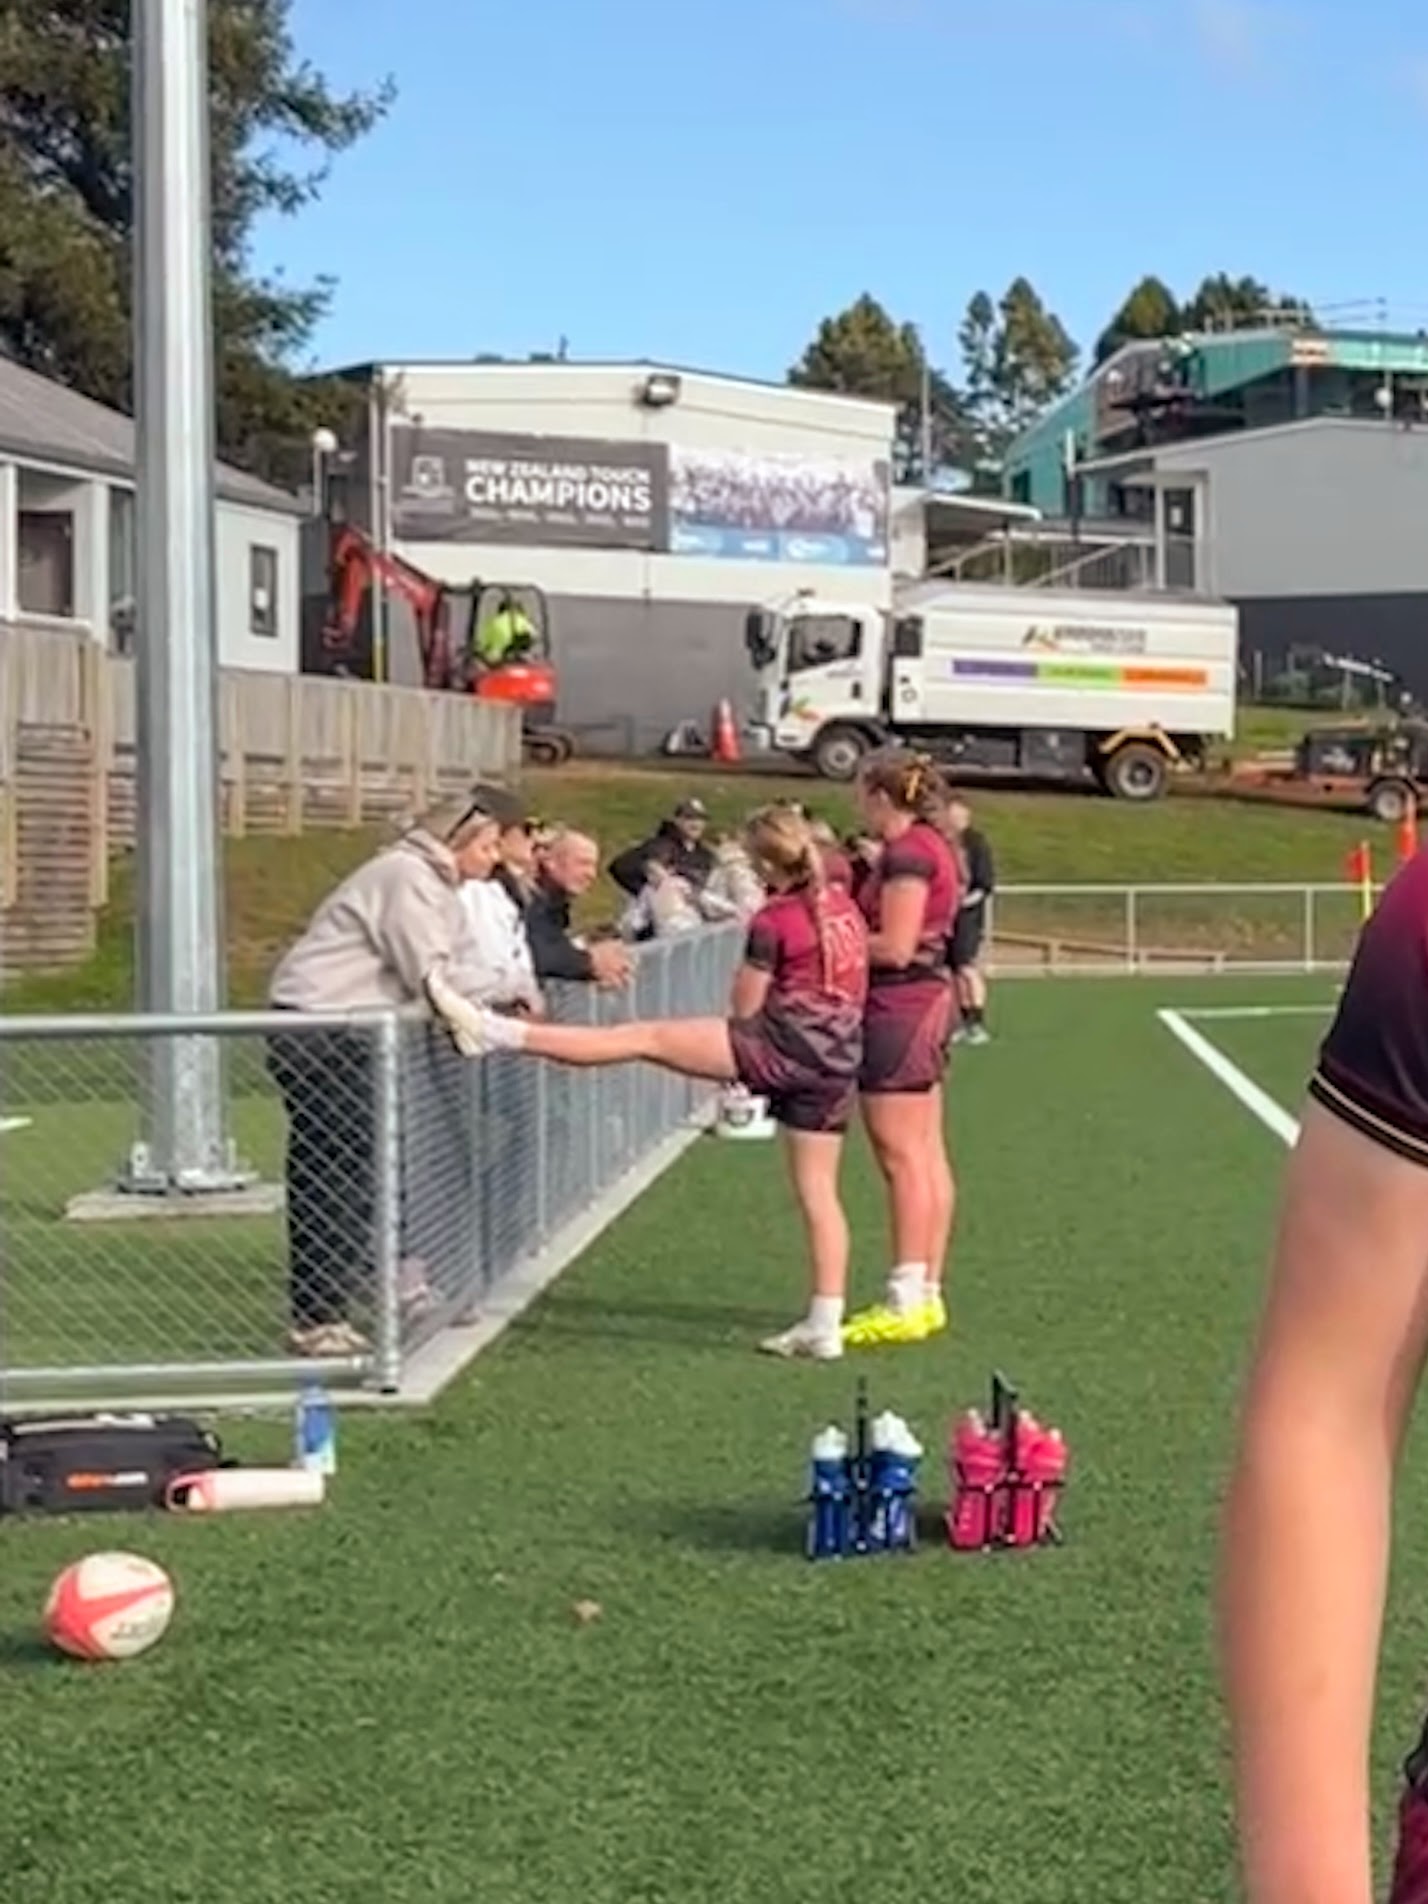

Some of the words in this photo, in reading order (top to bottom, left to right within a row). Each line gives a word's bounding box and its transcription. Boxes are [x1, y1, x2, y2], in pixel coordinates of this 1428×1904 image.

[464, 458, 507, 476] NEW
[509, 459, 588, 482] ZEALAND
[589, 465, 651, 484] TOUCH
[464, 475, 653, 513] CHAMPIONS
